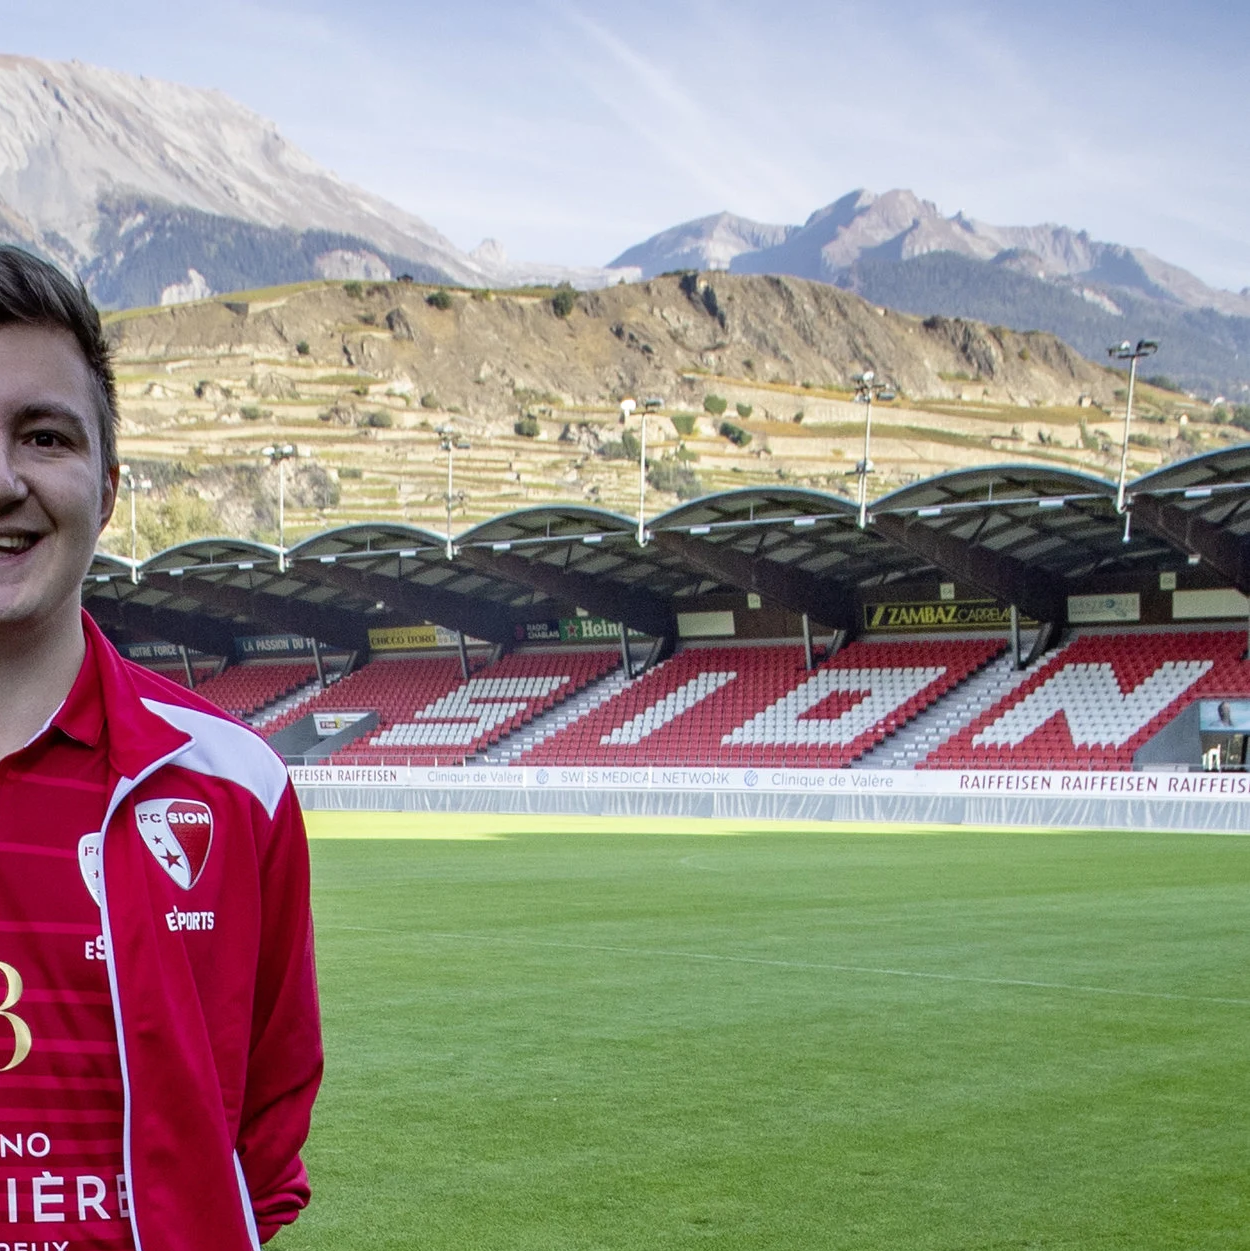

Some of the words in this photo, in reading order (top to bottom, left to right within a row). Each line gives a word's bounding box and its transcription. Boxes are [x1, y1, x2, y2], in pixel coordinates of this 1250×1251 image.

[888, 605, 958, 624] ZAMBAZ
[958, 606, 1031, 623] CARRELA
[581, 619, 647, 638] Hein
[337, 769, 397, 782] RAIFFEISEN
[473, 770, 487, 783] de
[491, 770, 524, 783] Valère
[561, 770, 598, 784] SWISS
[602, 771, 658, 784] MEDICAL
[662, 772, 730, 785] NETWORK
[771, 772, 824, 788] Clinique
[828, 772, 846, 786] de
[851, 773, 894, 788] Valère
[959, 774, 1052, 790] RAIFFEISEN
[1061, 775, 1159, 792] RAIFFEISEN
[1168, 777, 1250, 793] RAIFFEIS
[139, 813, 162, 824] FC
[167, 812, 210, 825] SION
